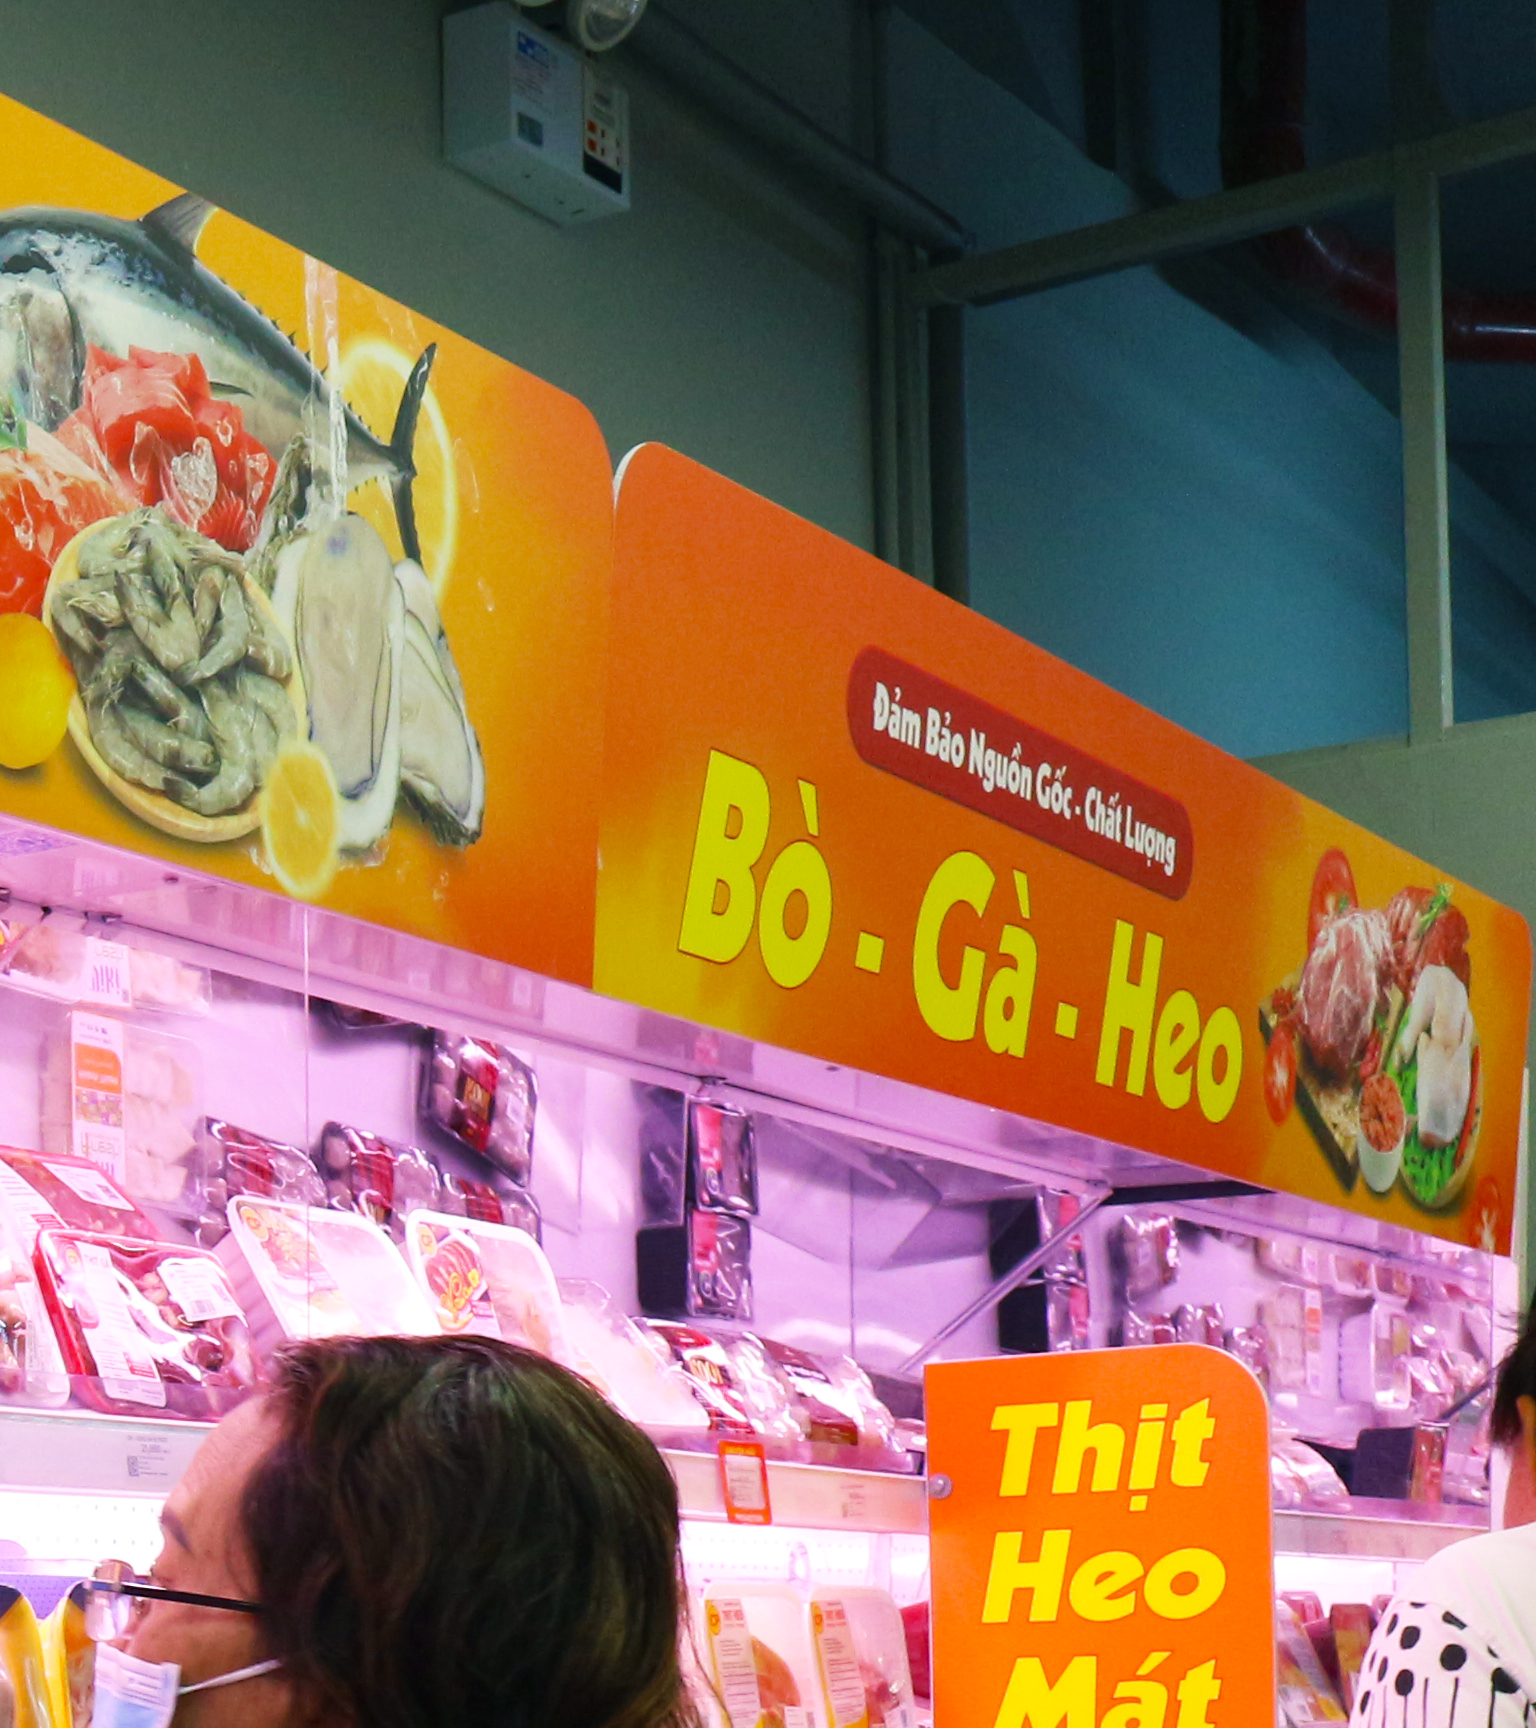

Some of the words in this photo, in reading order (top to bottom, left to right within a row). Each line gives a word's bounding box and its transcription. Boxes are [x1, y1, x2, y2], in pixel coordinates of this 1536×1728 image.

[873, 682, 922, 749] Đảm
[925, 706, 965, 769] Bảo
[969, 728, 1033, 801] Nguồn
[1036, 763, 1072, 820] Gốc
[1084, 786, 1123, 843] Chất
[1125, 805, 1177, 877] Lượng
[678, 747, 834, 990] Bò
[912, 849, 1040, 1060] Gà
[1095, 918, 1244, 1124] Heo
[989, 1397, 1216, 1512] Thịt
[981, 1529, 1227, 1624] Heo
